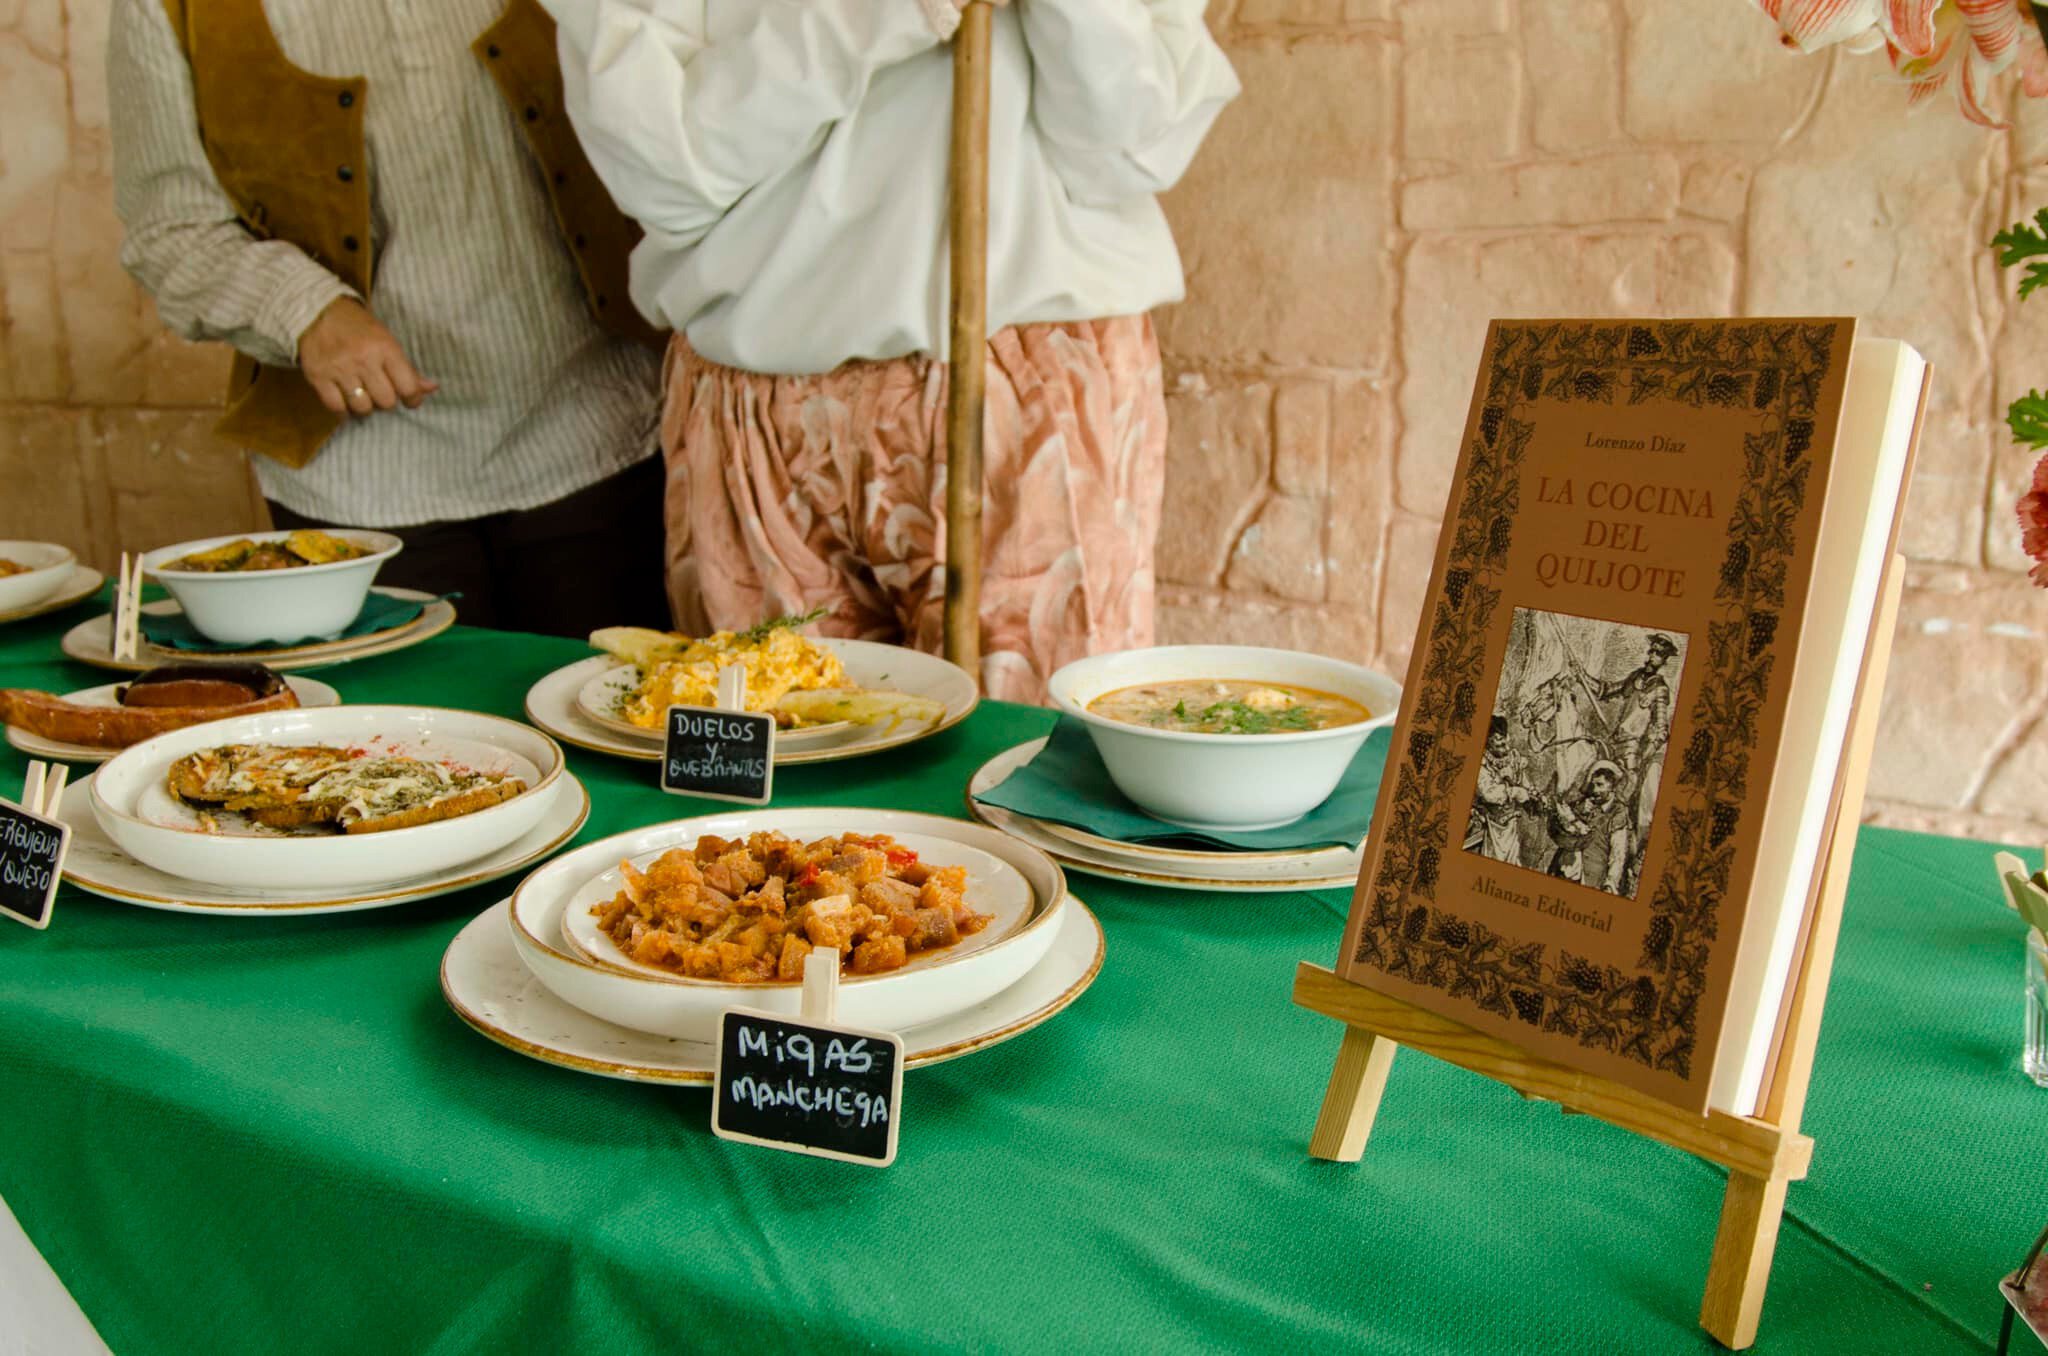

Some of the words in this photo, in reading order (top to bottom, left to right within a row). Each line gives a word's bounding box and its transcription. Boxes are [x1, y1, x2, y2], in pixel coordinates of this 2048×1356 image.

[1583, 431, 1646, 451] Lorenzo
[1650, 434, 1687, 454] Díaz
[1536, 476, 1574, 505] LA
[1587, 480, 1715, 519] COCINA
[1582, 519, 1649, 553] DEL
[1536, 552, 1686, 599] QUIJOTE
[674, 713, 755, 742] DUELOS
[706, 742, 719, 764] Y
[1472, 875, 1531, 908] Alianza
[1536, 894, 1613, 933] Editorial
